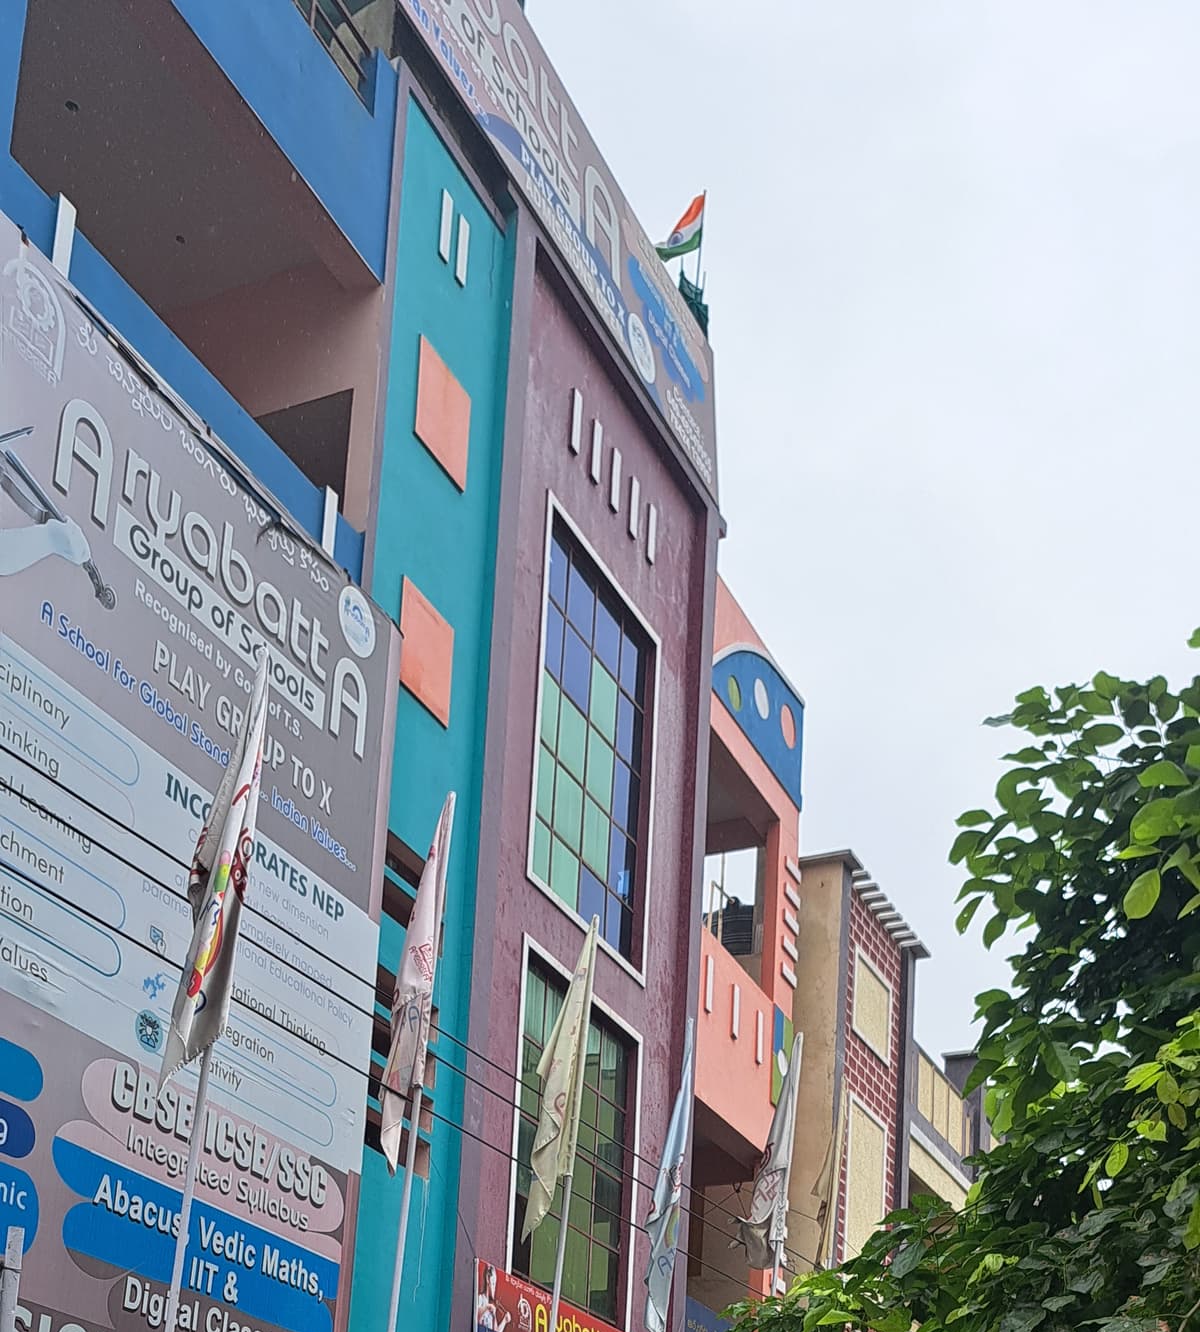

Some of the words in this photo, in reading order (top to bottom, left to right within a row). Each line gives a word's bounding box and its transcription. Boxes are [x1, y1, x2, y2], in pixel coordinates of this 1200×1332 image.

[491, 55, 571, 206] Schools
[520, 144, 555, 204] PLAY
[556, 203, 600, 276] GROUP
[599, 271, 615, 306] TO
[129, 523, 204, 612] Group
[211, 604, 235, 637] of
[239, 622, 316, 712] Schools
[0, 664, 70, 730] ciplinary
[135, 579, 213, 661] Recognised
[216, 651, 233, 678] by
[269, 702, 282, 719] of
[282, 709, 304, 741] T.S.
[0, 720, 60, 779] hinking
[40, 600, 54, 628] A
[57, 614, 110, 672] School
[114, 658, 137, 692] for
[139, 682, 189, 735] Global
[190, 723, 231, 769] Stand
[271, 785, 309, 833] Indian
[153, 639, 211, 712] PLAY
[216, 695, 285, 770] GRUP
[291, 754, 317, 798] TO
[319, 780, 334, 816] X
[0, 831, 65, 884] chment
[0, 886, 34, 921] tion
[240, 916, 290, 958] ompletely
[281, 890, 329, 941] dimension
[313, 880, 345, 922] NEP
[231, 981, 277, 1020] tational
[280, 1008, 327, 1056] Thinking
[236, 941, 267, 973] tional
[269, 959, 326, 1006] Educational
[327, 1000, 355, 1030] Policy
[224, 1023, 275, 1064] egration
[112, 1061, 328, 1207] CBSEICSE/SSC
[126, 1124, 232, 1194] Integrted
[237, 1179, 310, 1231] Syllabus
[189, 1257, 220, 1293] IIT
[223, 1271, 240, 1304] &
[199, 1216, 256, 1268] Vedic
[262, 1244, 325, 1302] Maths,
